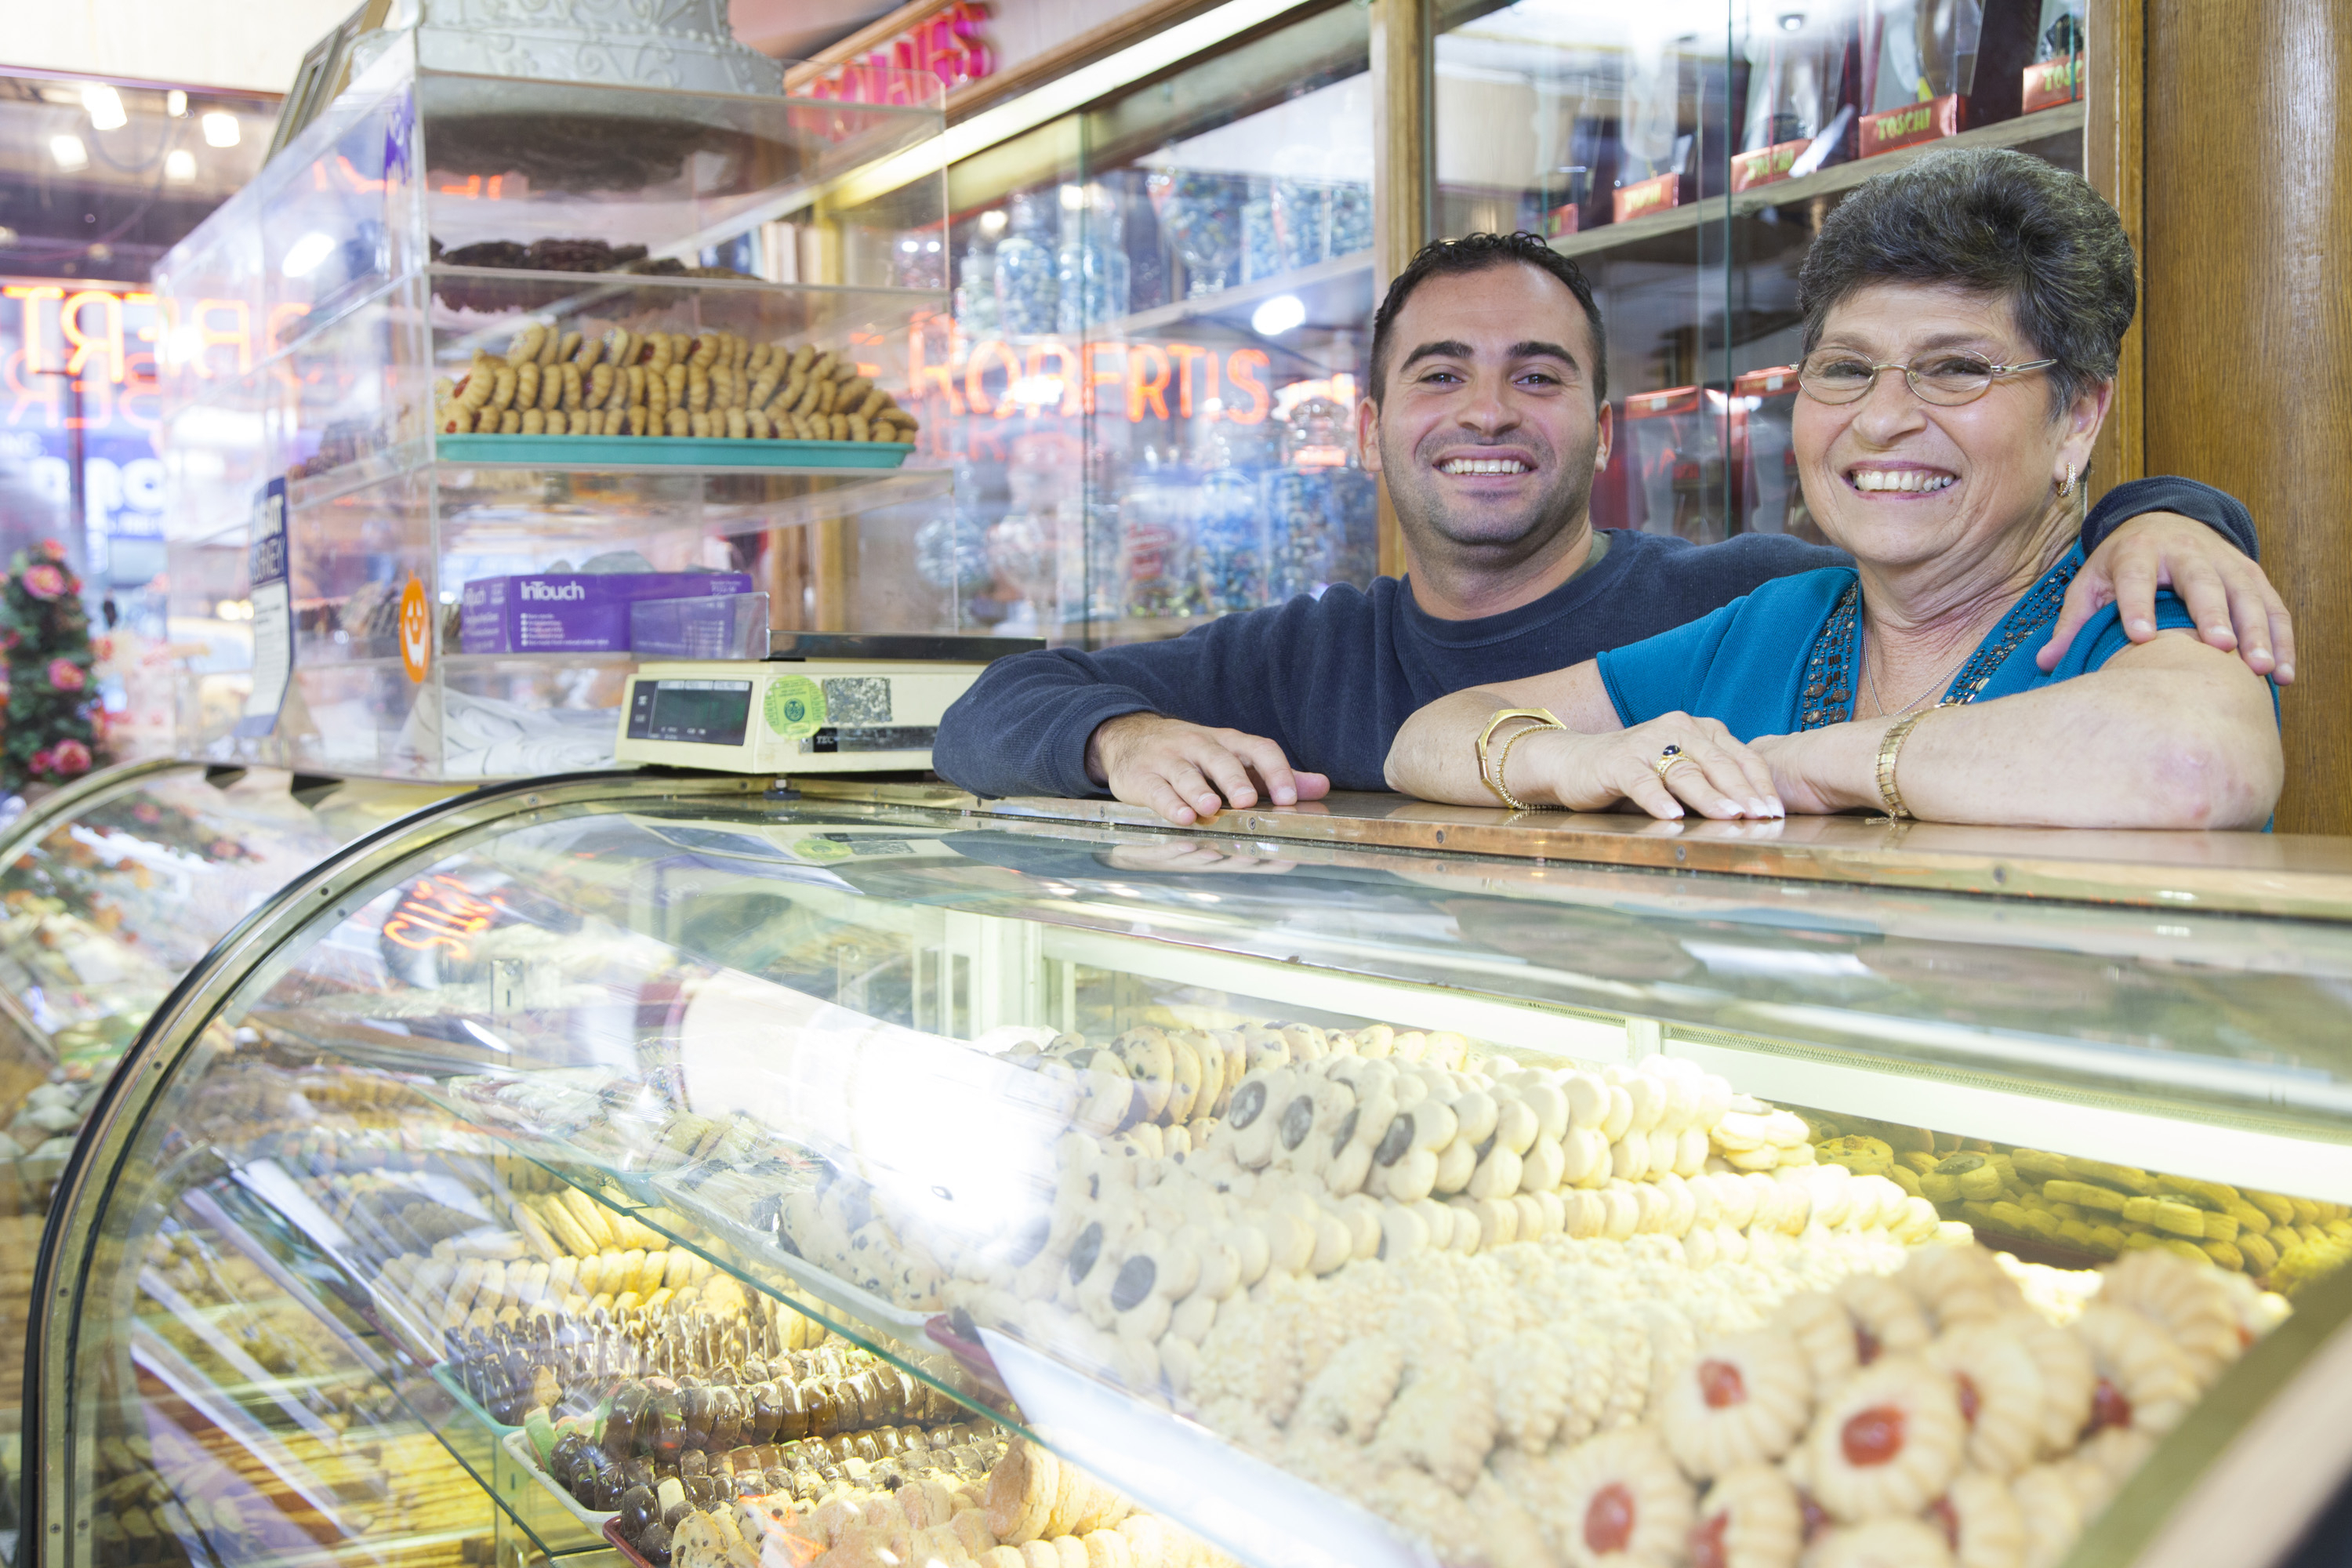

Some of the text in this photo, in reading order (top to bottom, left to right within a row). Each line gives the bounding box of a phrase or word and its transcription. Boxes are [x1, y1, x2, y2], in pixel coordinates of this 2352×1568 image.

[1876, 107, 1932, 142] TOSCHI
[521, 580, 585, 601] InTouch
[816, 735, 834, 744] TEC
